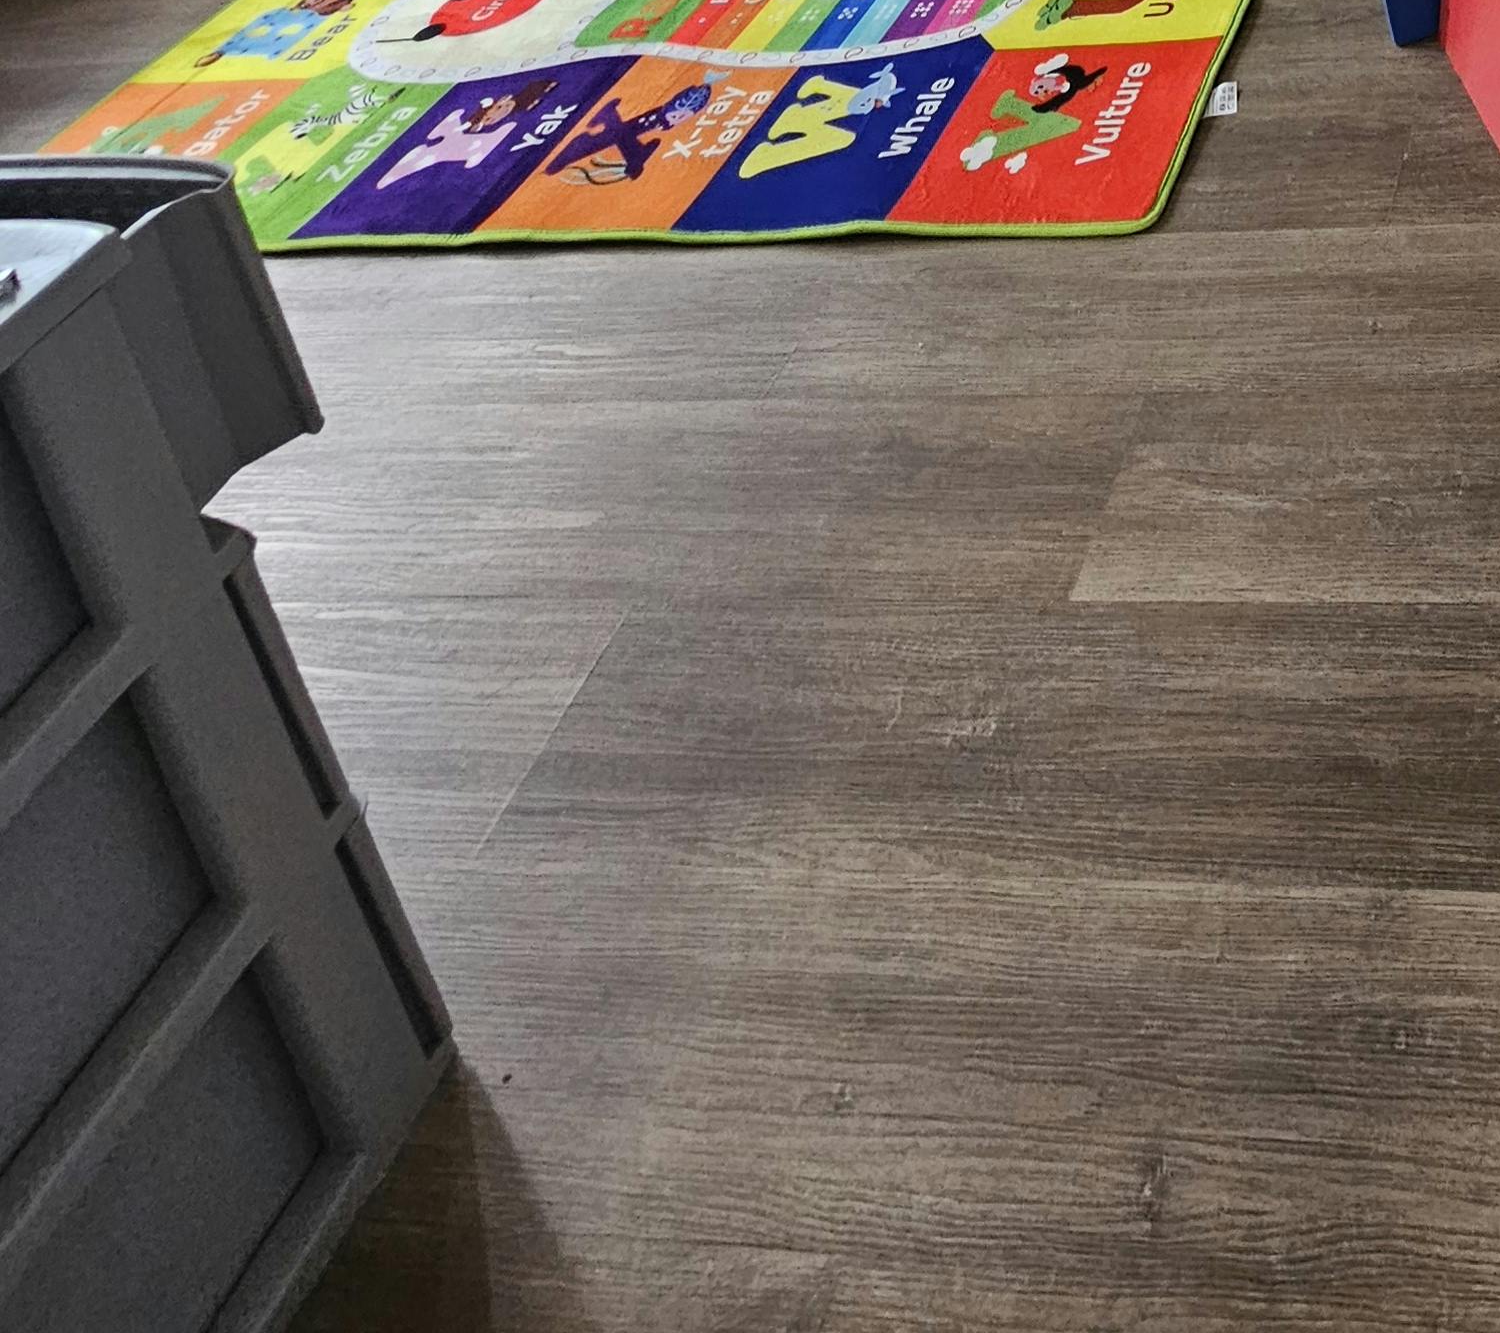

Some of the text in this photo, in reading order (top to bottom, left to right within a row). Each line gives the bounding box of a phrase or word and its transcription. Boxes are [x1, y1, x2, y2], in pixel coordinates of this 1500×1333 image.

[287, 13, 362, 62] Bear
[315, 104, 419, 185] Zebra
[509, 102, 579, 153] Yak
[661, 84, 748, 161] X-ray
[699, 88, 775, 160] tetra
[878, 75, 956, 159] Whale
[1074, 60, 1152, 166] Vulture
